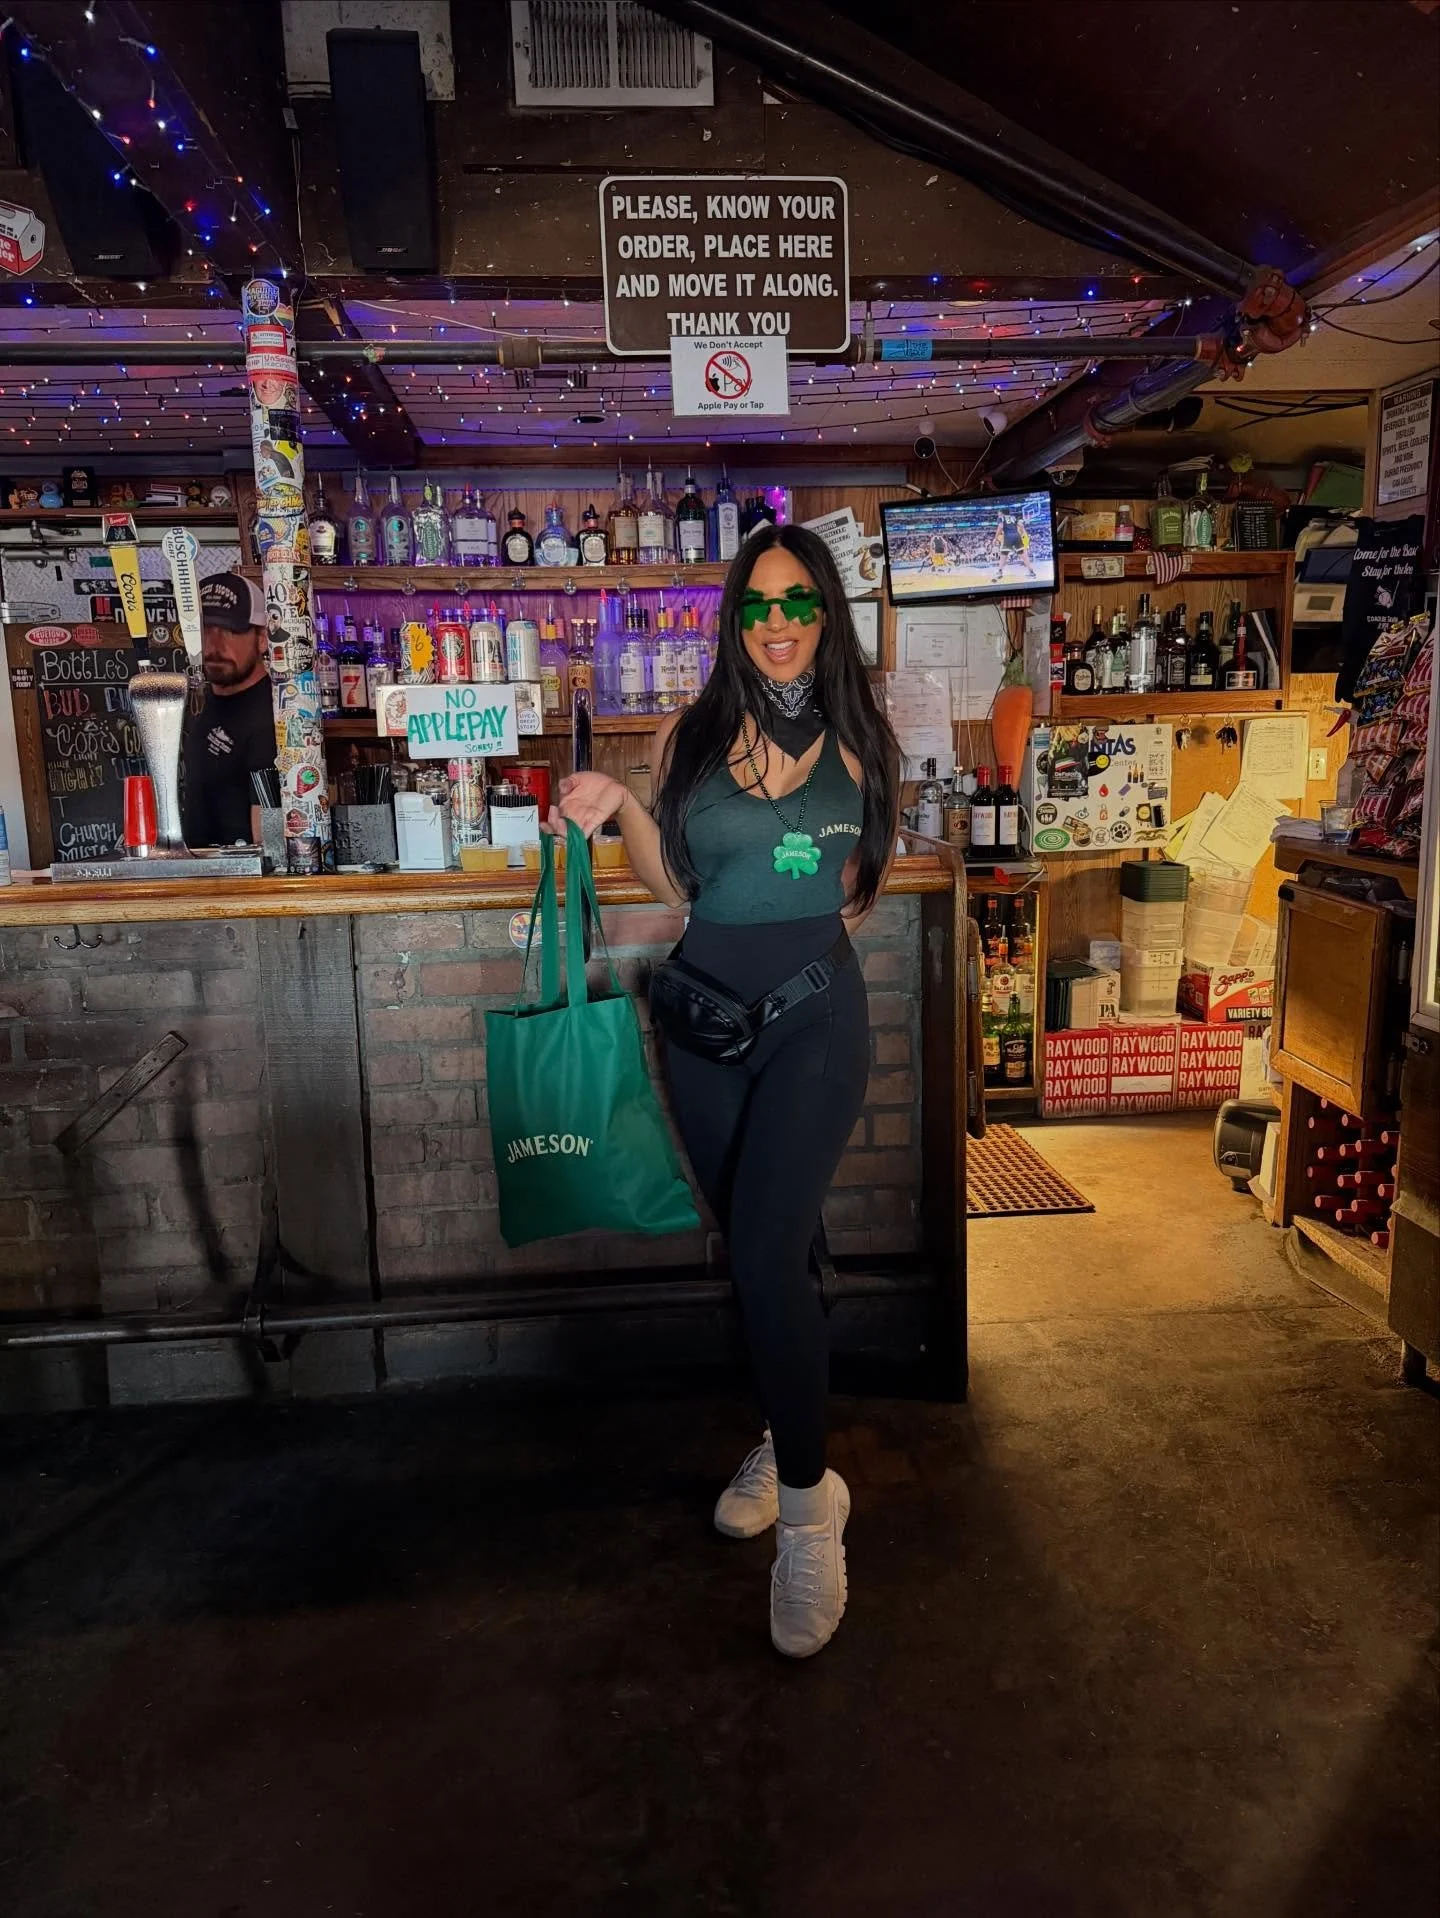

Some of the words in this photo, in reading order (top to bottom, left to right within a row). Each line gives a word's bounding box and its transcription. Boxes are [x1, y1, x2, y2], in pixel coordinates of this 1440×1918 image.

[612, 195, 698, 224] PLEASE,
[706, 195, 770, 220] KNOW
[778, 195, 836, 220] YOUR
[618, 235, 696, 263] ORDER,
[704, 235, 770, 258] PLACE
[778, 235, 833, 258] HERE
[616, 274, 660, 297] AND
[668, 274, 728, 296] MOVE
[736, 274, 755, 296] IT
[762, 273, 839, 296] ALONG.
[667, 312, 741, 336] THANK
[748, 312, 790, 335] YOU
[709, 341, 732, 349] Don't
[734, 341, 763, 350] Accept
[697, 402, 721, 410] Apple
[723, 401, 739, 410] Pay
[750, 401, 764, 410] Tap
[1353, 548, 1378, 561] Come
[1376, 547, 1389, 562] for
[1361, 565, 1382, 579] Stay
[1381, 565, 1392, 579] for
[120, 571, 137, 612] Coors
[342, 675, 361, 705] 7
[446, 688, 476, 709] NO
[407, 705, 508, 744] APPLEPAY
[781, 850, 811, 860] JAMESON
[1227, 1007, 1260, 1019] VARIETY
[1262, 1007, 1272, 1018] BO
[1045, 1037, 1108, 1058] RAYWOOD
[1113, 1035, 1175, 1054] RAYWOOD
[1181, 1030, 1243, 1049] RAYWOOD
[1045, 1058, 1108, 1077] RAYWOOD
[1112, 1054, 1174, 1074] RAYWOOD
[1180, 1050, 1241, 1069] RAYWOOD
[1045, 1077, 1108, 1097] RAYWOOD
[1179, 1069, 1240, 1088] RAYWOOD
[1110, 1094, 1172, 1114] RAYWOOD
[1178, 1088, 1239, 1108] RAYWOOD
[507, 1134, 590, 1164] JAMESON
